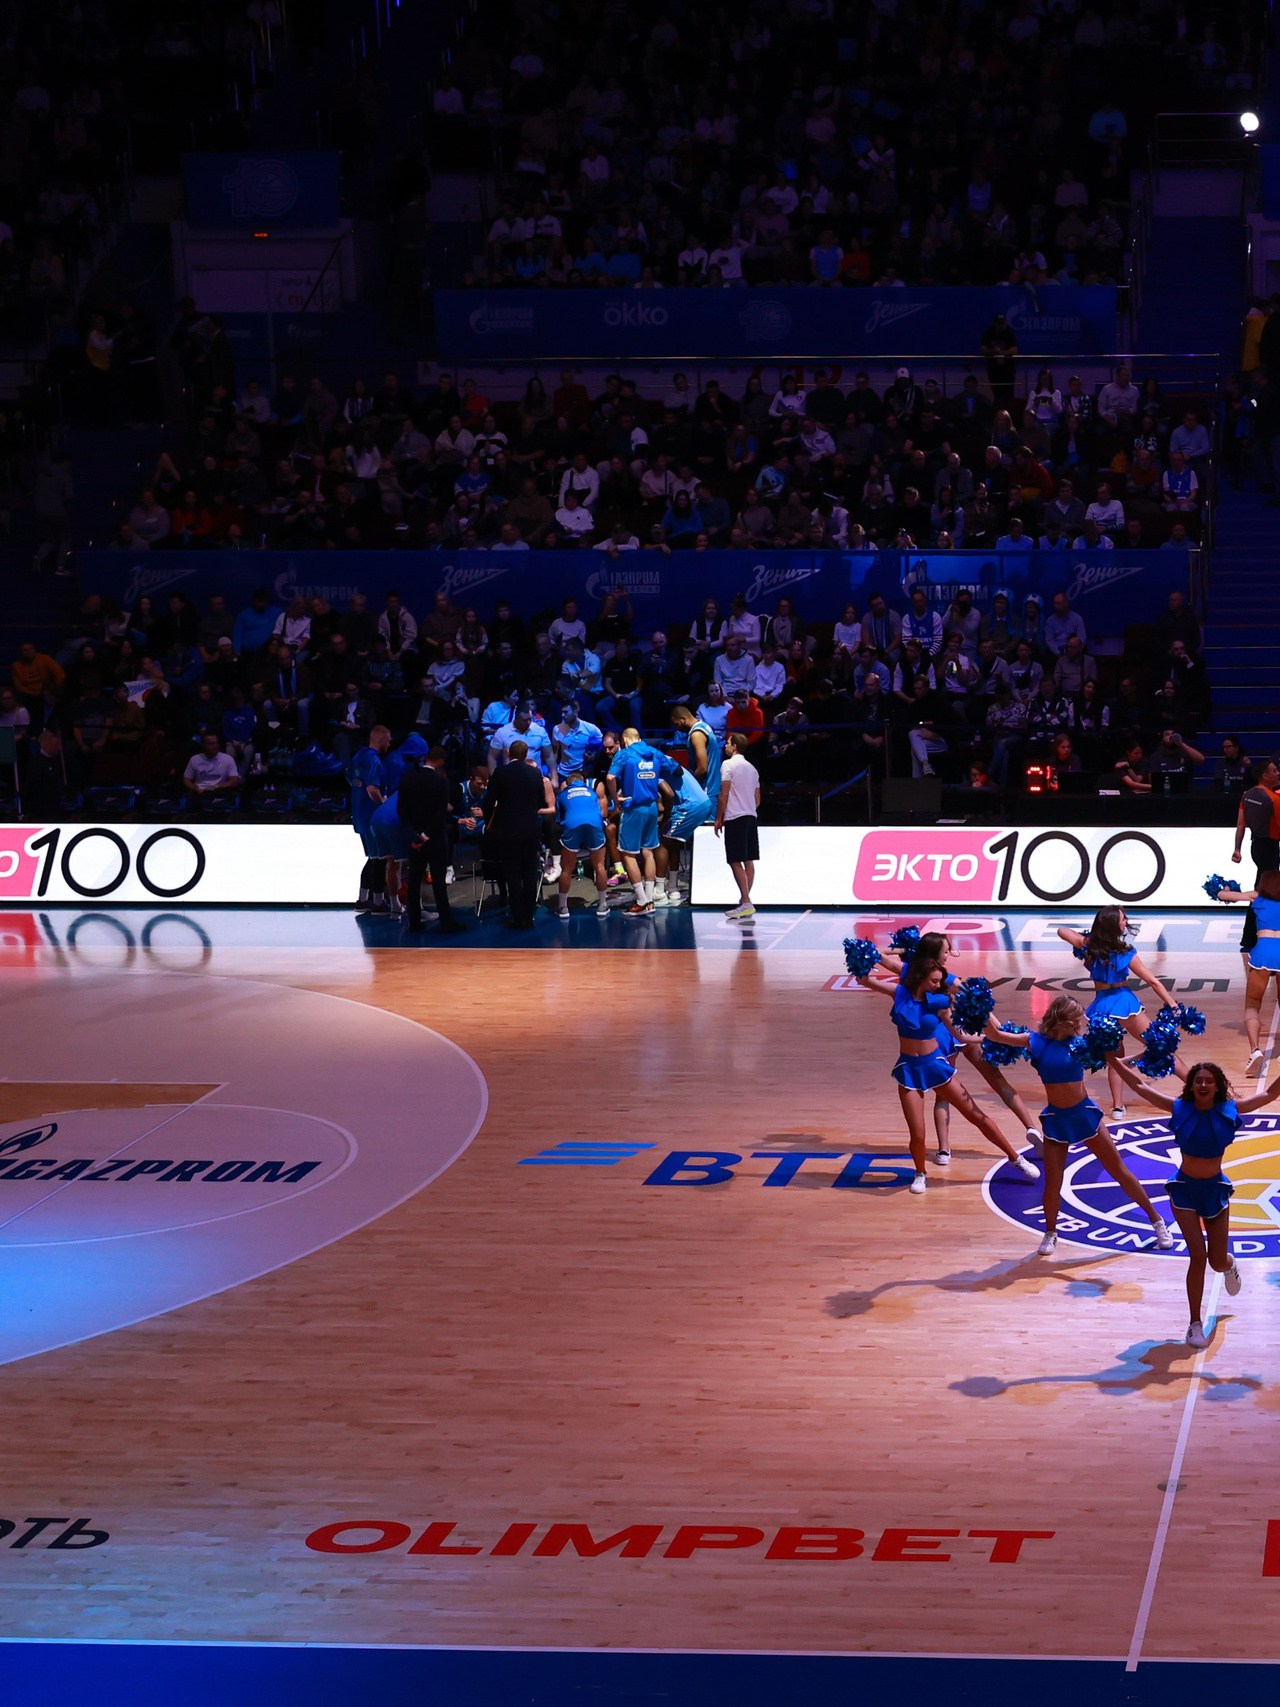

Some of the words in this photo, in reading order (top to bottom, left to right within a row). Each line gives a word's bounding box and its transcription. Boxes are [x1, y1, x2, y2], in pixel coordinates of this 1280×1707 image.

[610, 571, 660, 585] ГАЗПРОМ
[31, 828, 206, 898] 100
[871, 853, 979, 882] ЭКТО
[989, 831, 1166, 901] 100
[642, 1151, 919, 1188] ВТБ
[305, 1520, 1056, 1564] OLIMPBET
